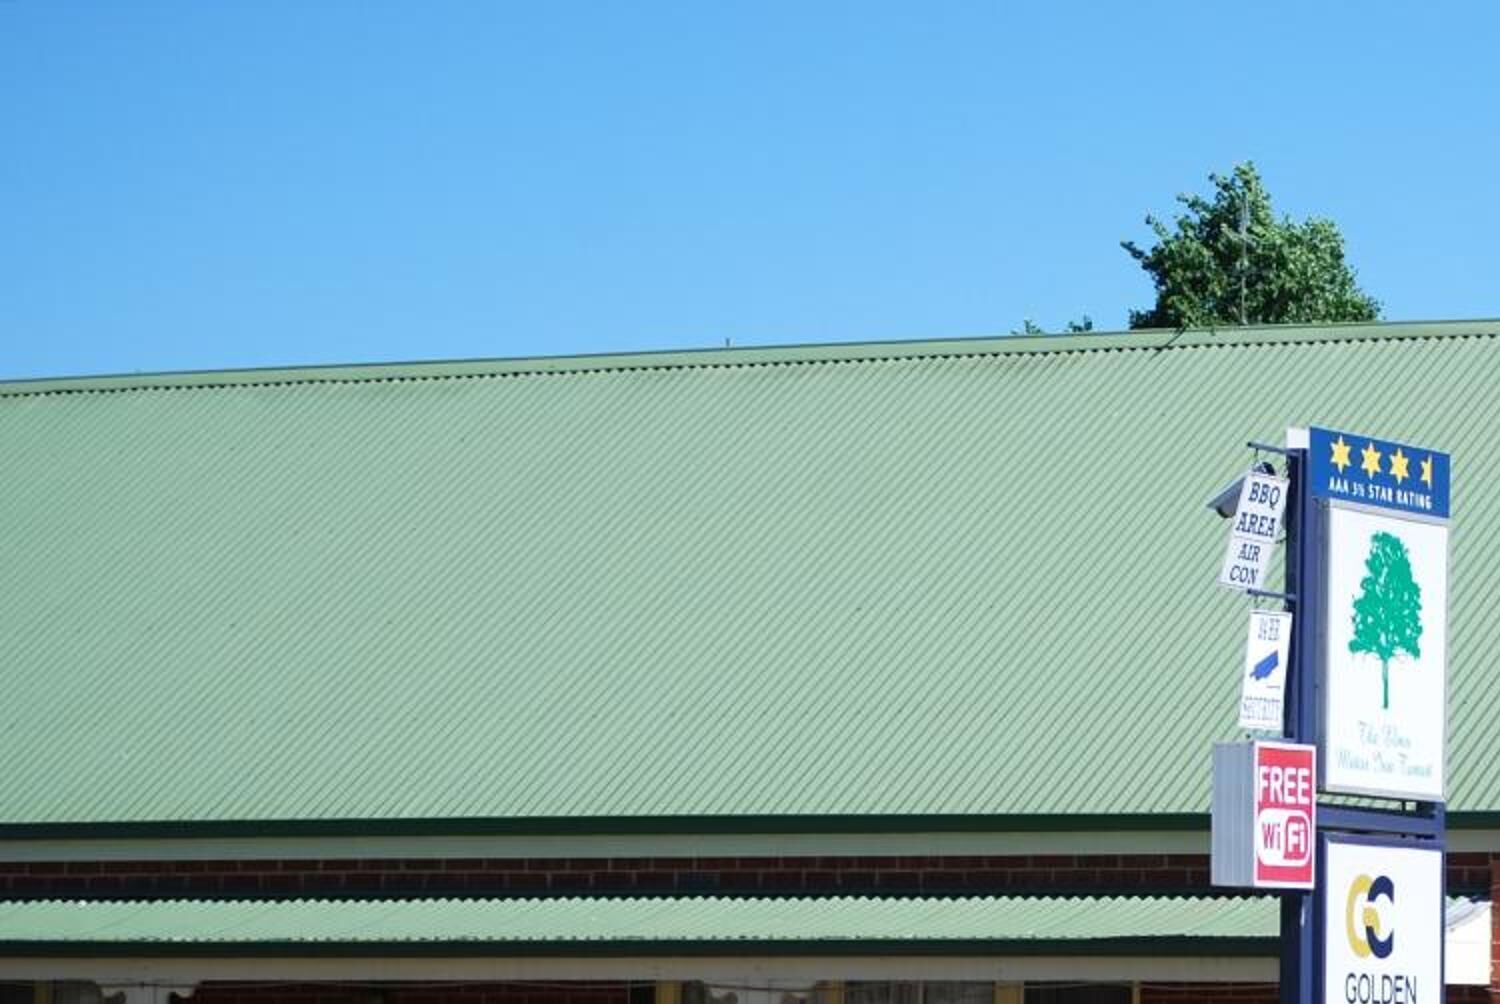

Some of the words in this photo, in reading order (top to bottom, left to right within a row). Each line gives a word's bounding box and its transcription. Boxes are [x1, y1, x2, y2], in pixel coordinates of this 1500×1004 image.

[1248, 481, 1281, 509] BBQ
[1368, 484, 1393, 503] STAR
[1396, 489, 1432, 510] RATING
[1236, 511, 1277, 538] AREA
[1238, 543, 1261, 562] AIR
[1229, 566, 1259, 584] CON
[1259, 766, 1310, 804] FREE
